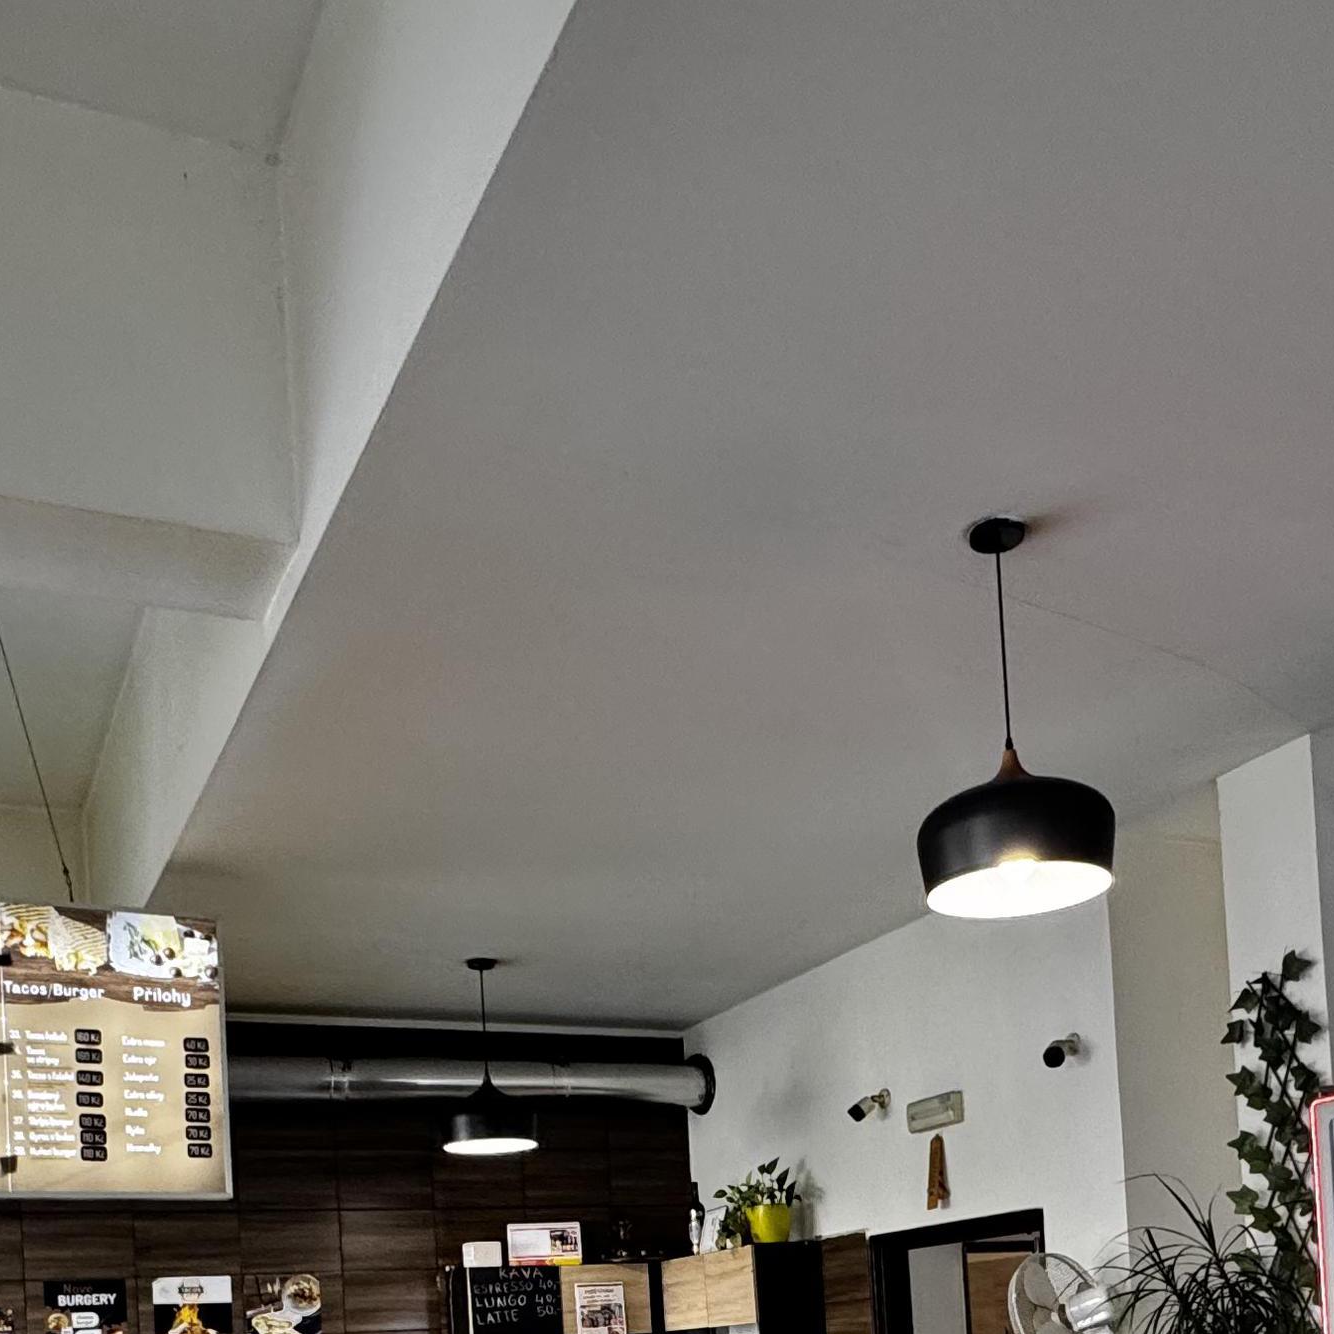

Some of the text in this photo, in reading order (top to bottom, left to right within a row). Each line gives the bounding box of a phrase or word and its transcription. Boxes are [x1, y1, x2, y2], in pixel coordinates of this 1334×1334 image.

[3, 981, 105, 1001] Tacos/Burger
[133, 986, 192, 1008] Přílohy
[473, 1281, 533, 1295] ESPRESSO
[57, 1293, 117, 1307] BURGERY
[475, 1294, 527, 1309] LUNGO
[476, 1309, 519, 1326] LATTE
